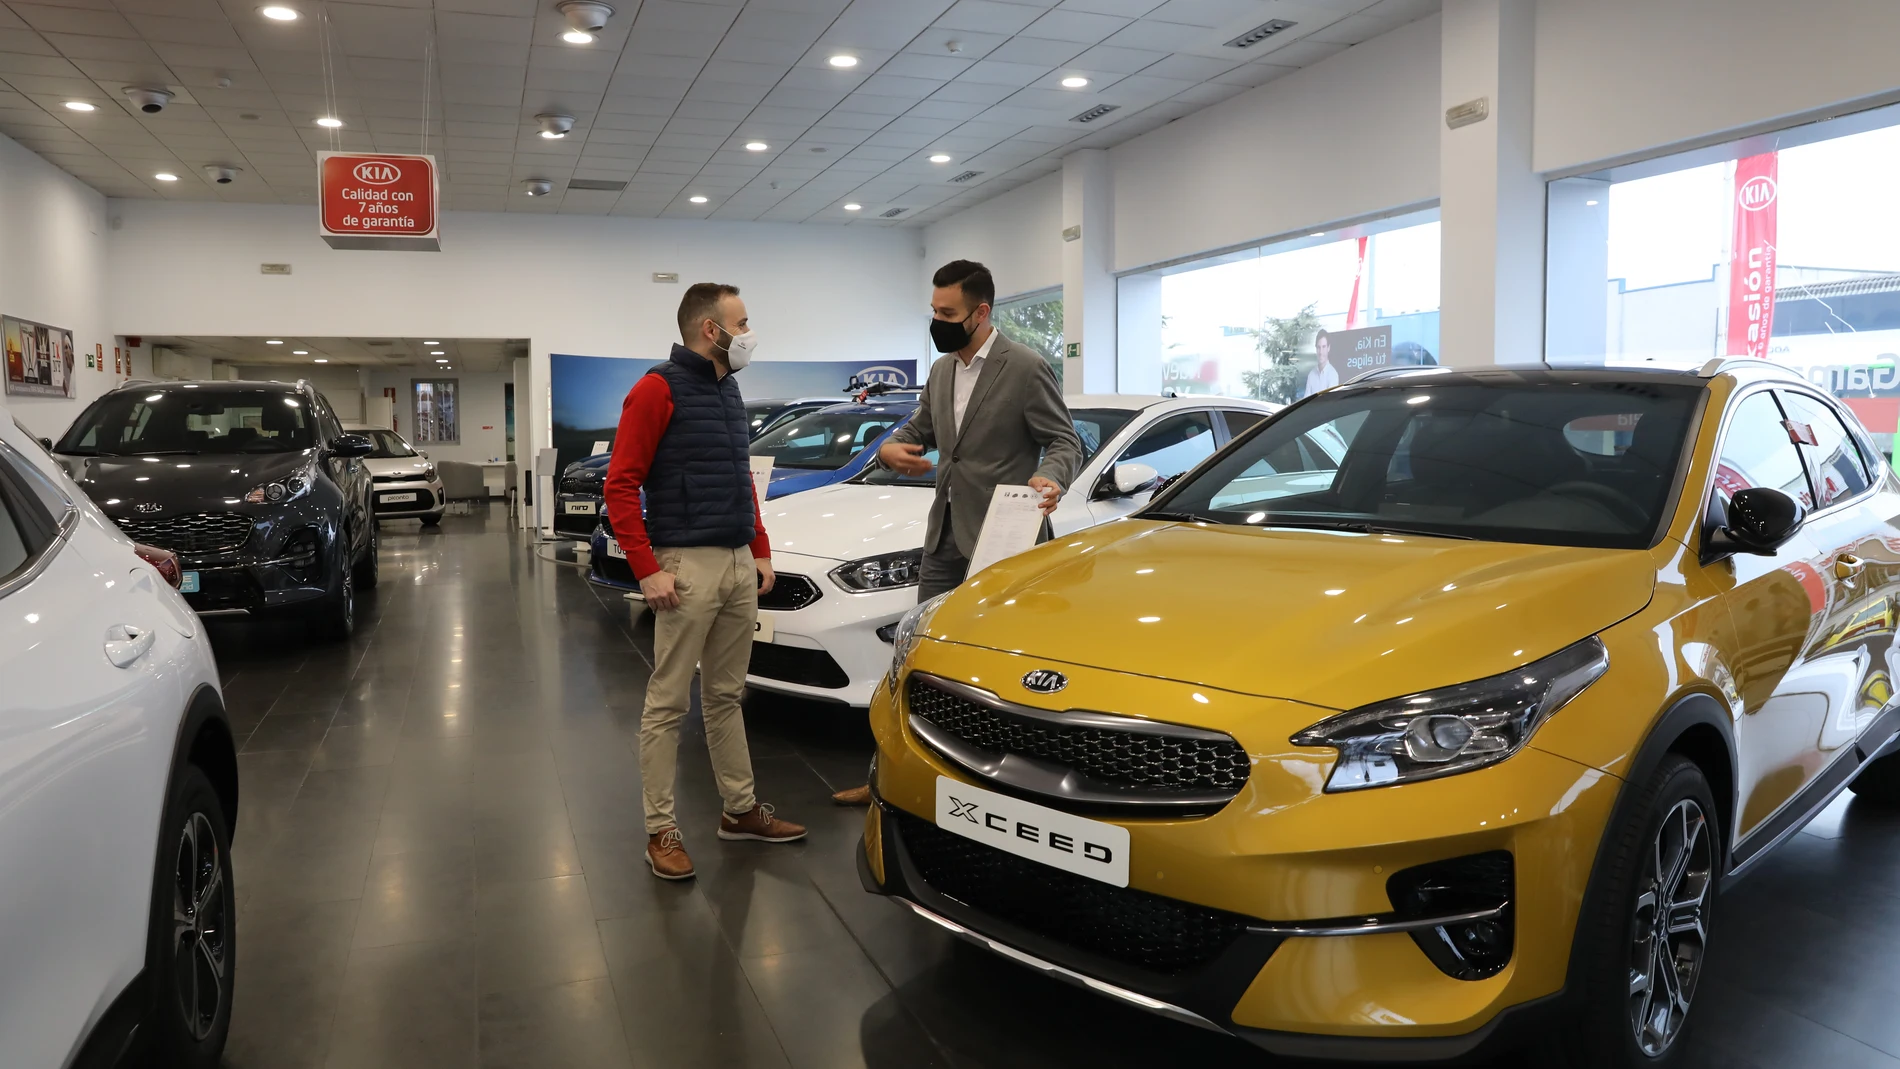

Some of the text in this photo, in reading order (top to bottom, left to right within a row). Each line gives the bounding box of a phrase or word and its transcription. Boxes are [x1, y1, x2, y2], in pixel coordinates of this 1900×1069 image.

[361, 166, 394, 180] KIA
[341, 188, 414, 201] Calidad con
[1744, 183, 1770, 205] KIA
[358, 202, 399, 214] 7 años
[342, 215, 415, 229] de garantía
[1760, 312, 1770, 340] años
[863, 373, 900, 384] KIA
[1026, 671, 1058, 689] KIA
[948, 795, 1113, 874] XCEED
